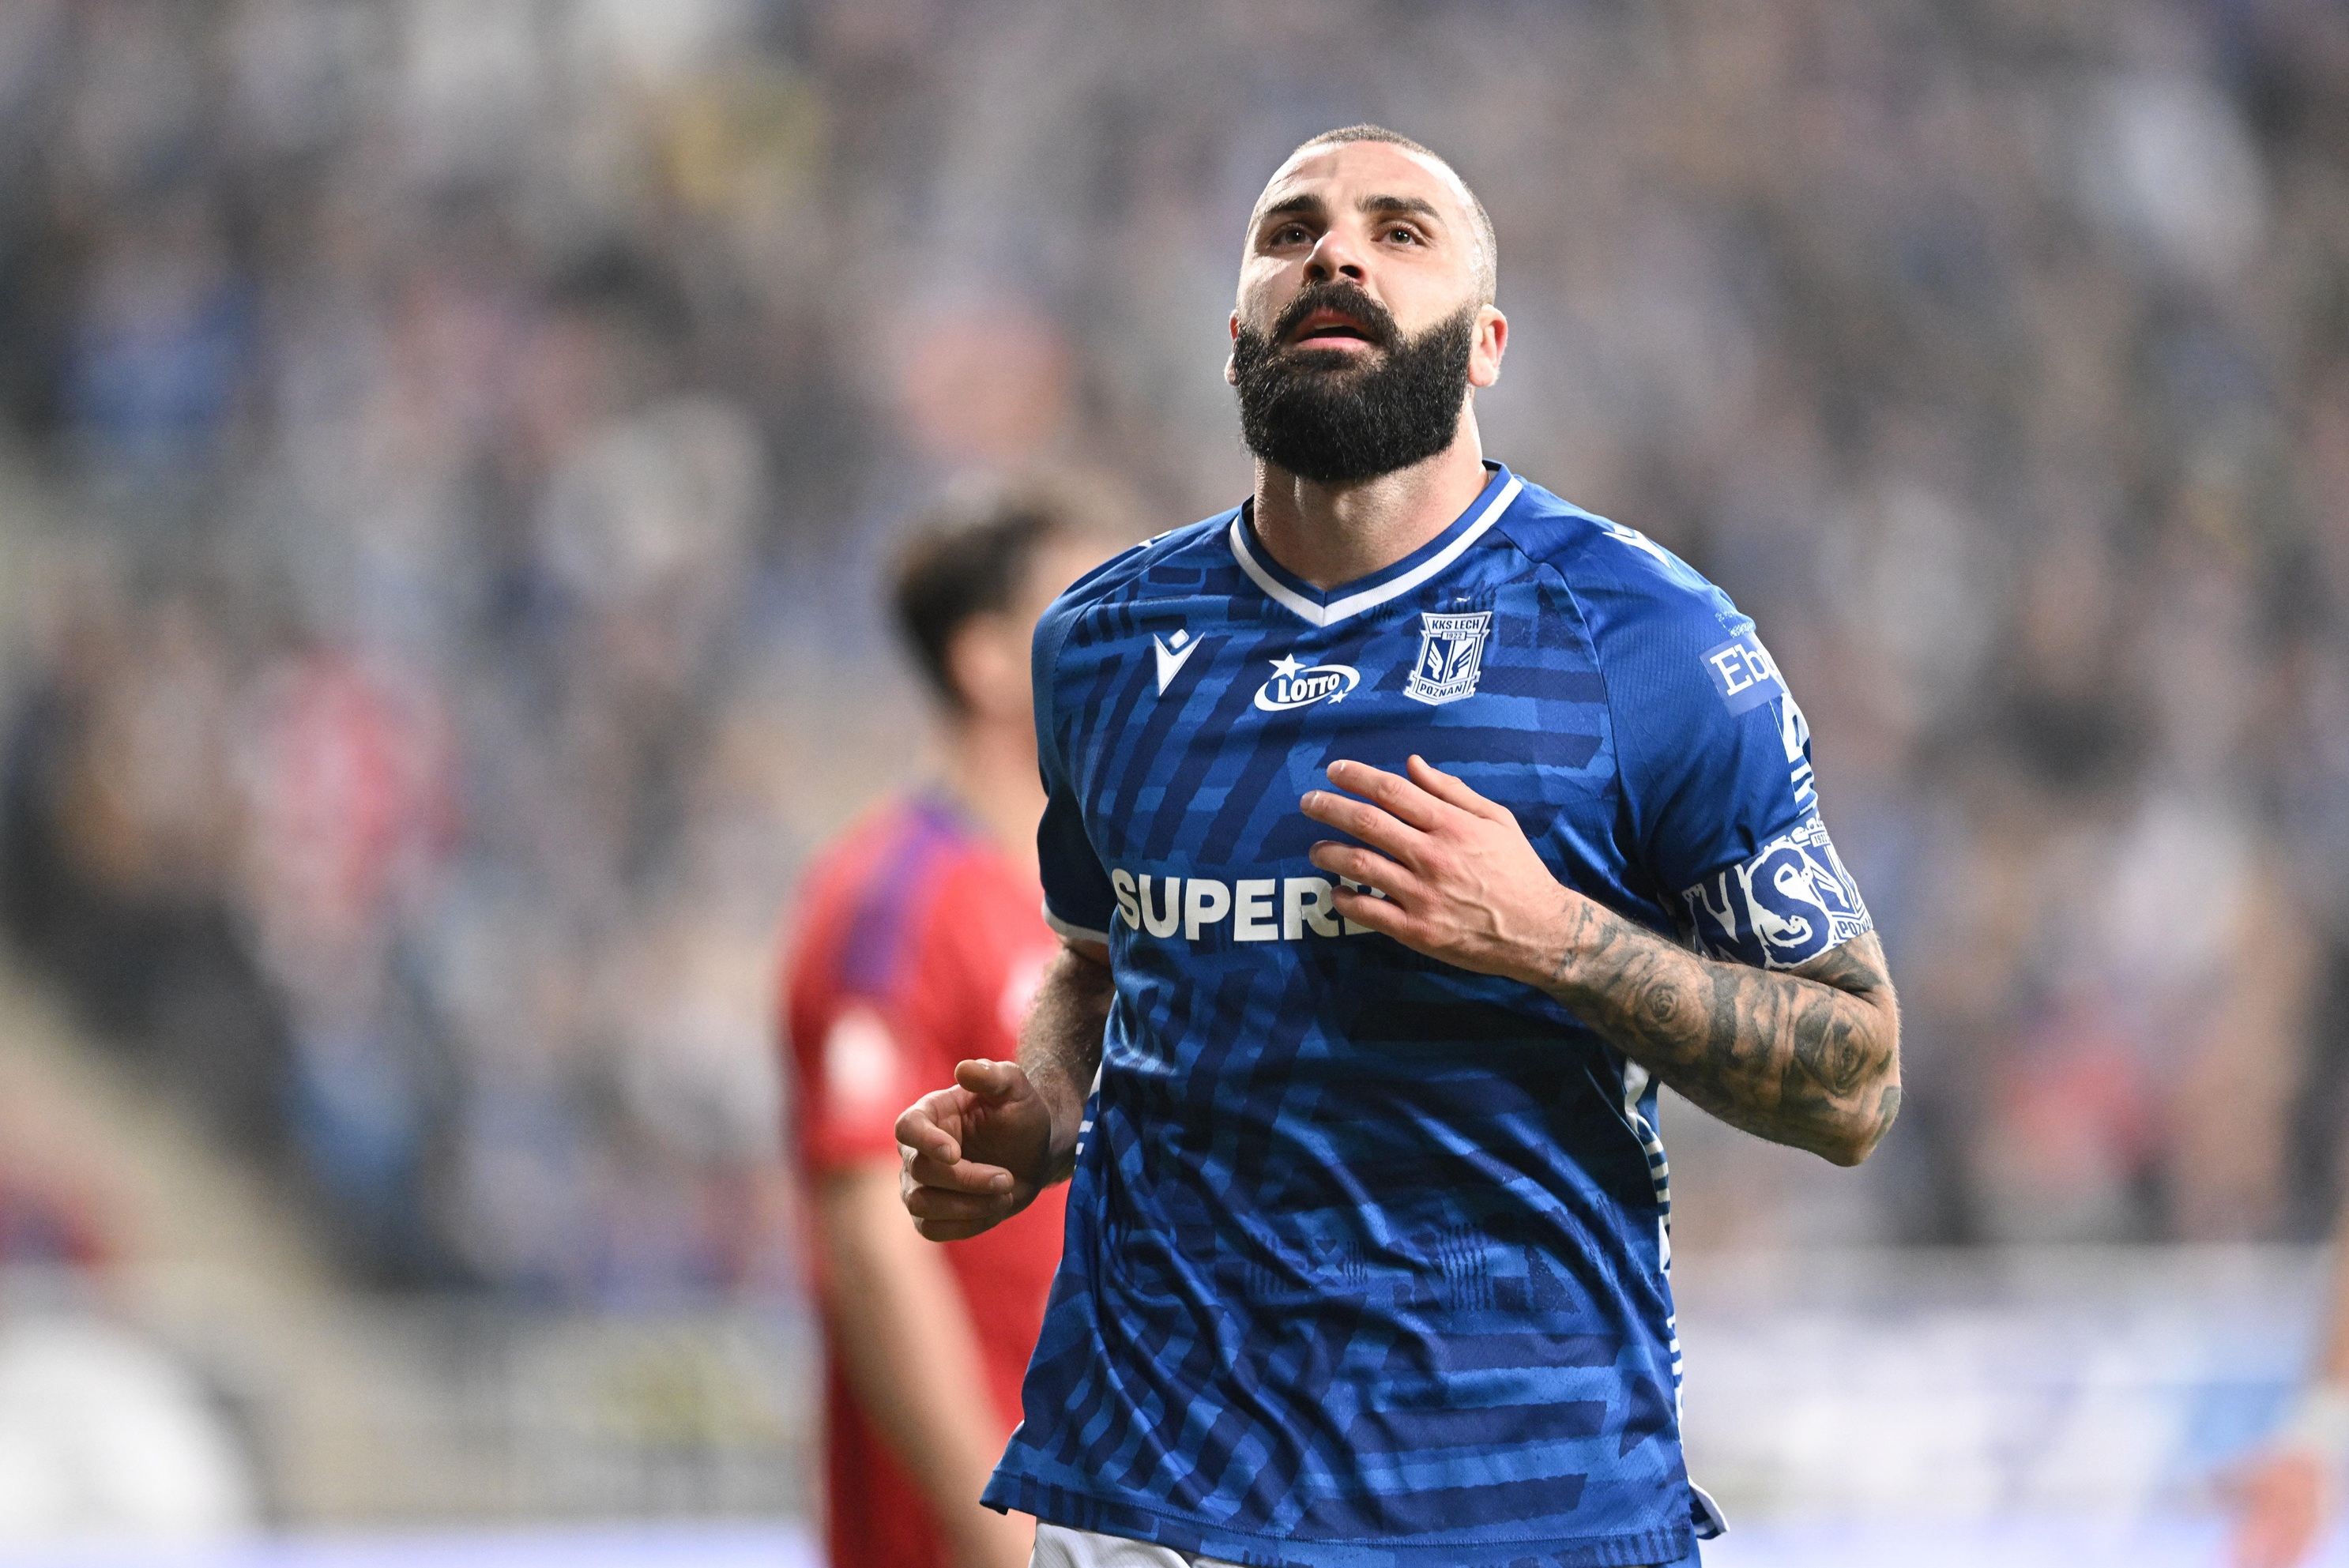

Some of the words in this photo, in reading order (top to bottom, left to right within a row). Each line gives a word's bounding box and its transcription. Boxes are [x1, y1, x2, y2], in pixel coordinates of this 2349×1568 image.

[1432, 619, 1452, 630] KKS
[1454, 619, 1480, 630] LECH
[1278, 673, 1340, 702] LOTTO
